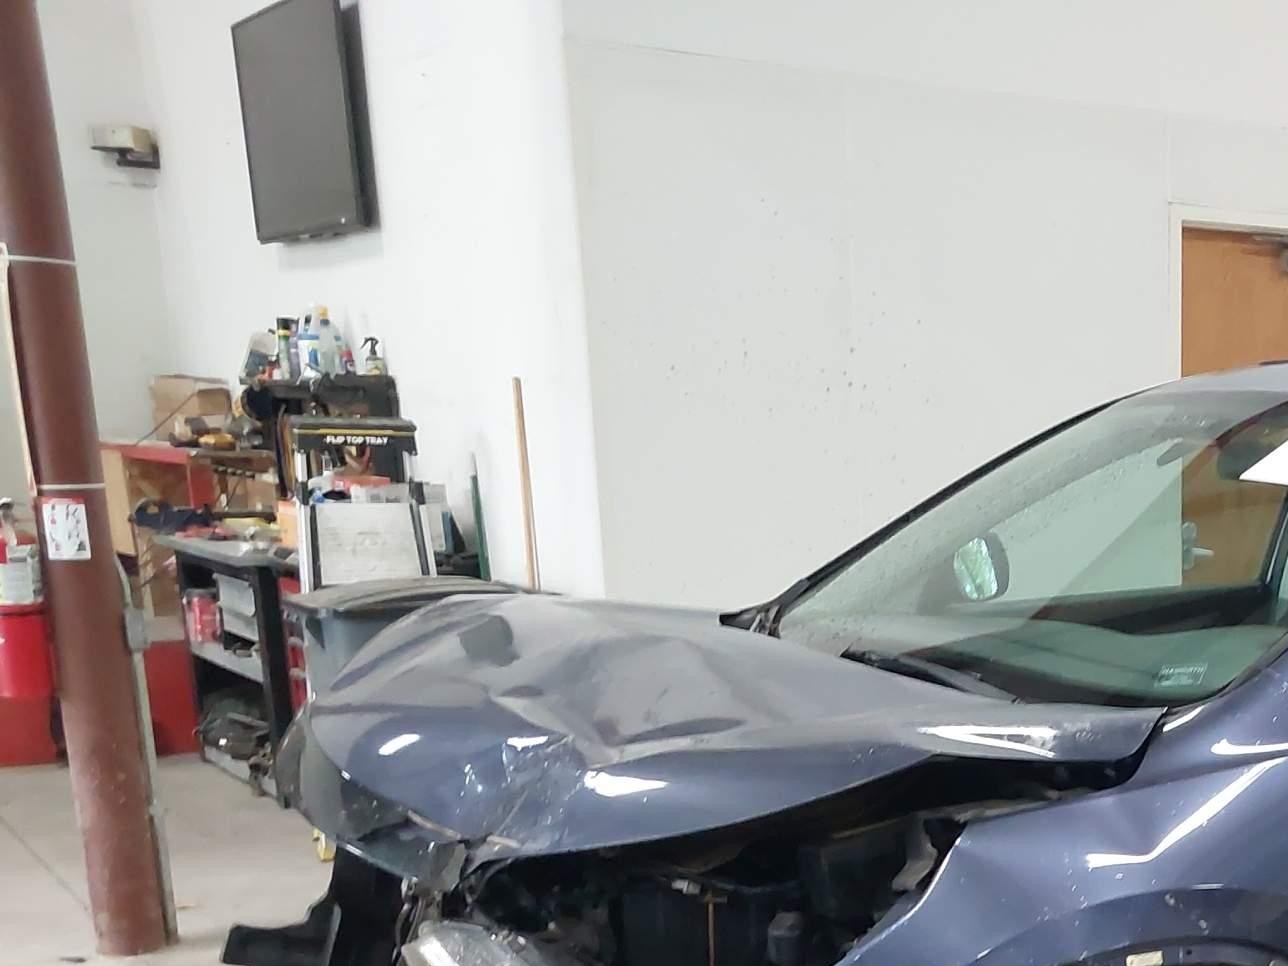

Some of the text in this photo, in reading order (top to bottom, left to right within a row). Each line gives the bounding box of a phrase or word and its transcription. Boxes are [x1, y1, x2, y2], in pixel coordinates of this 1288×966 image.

[326, 435, 388, 446] FLIP TOP TRAY
